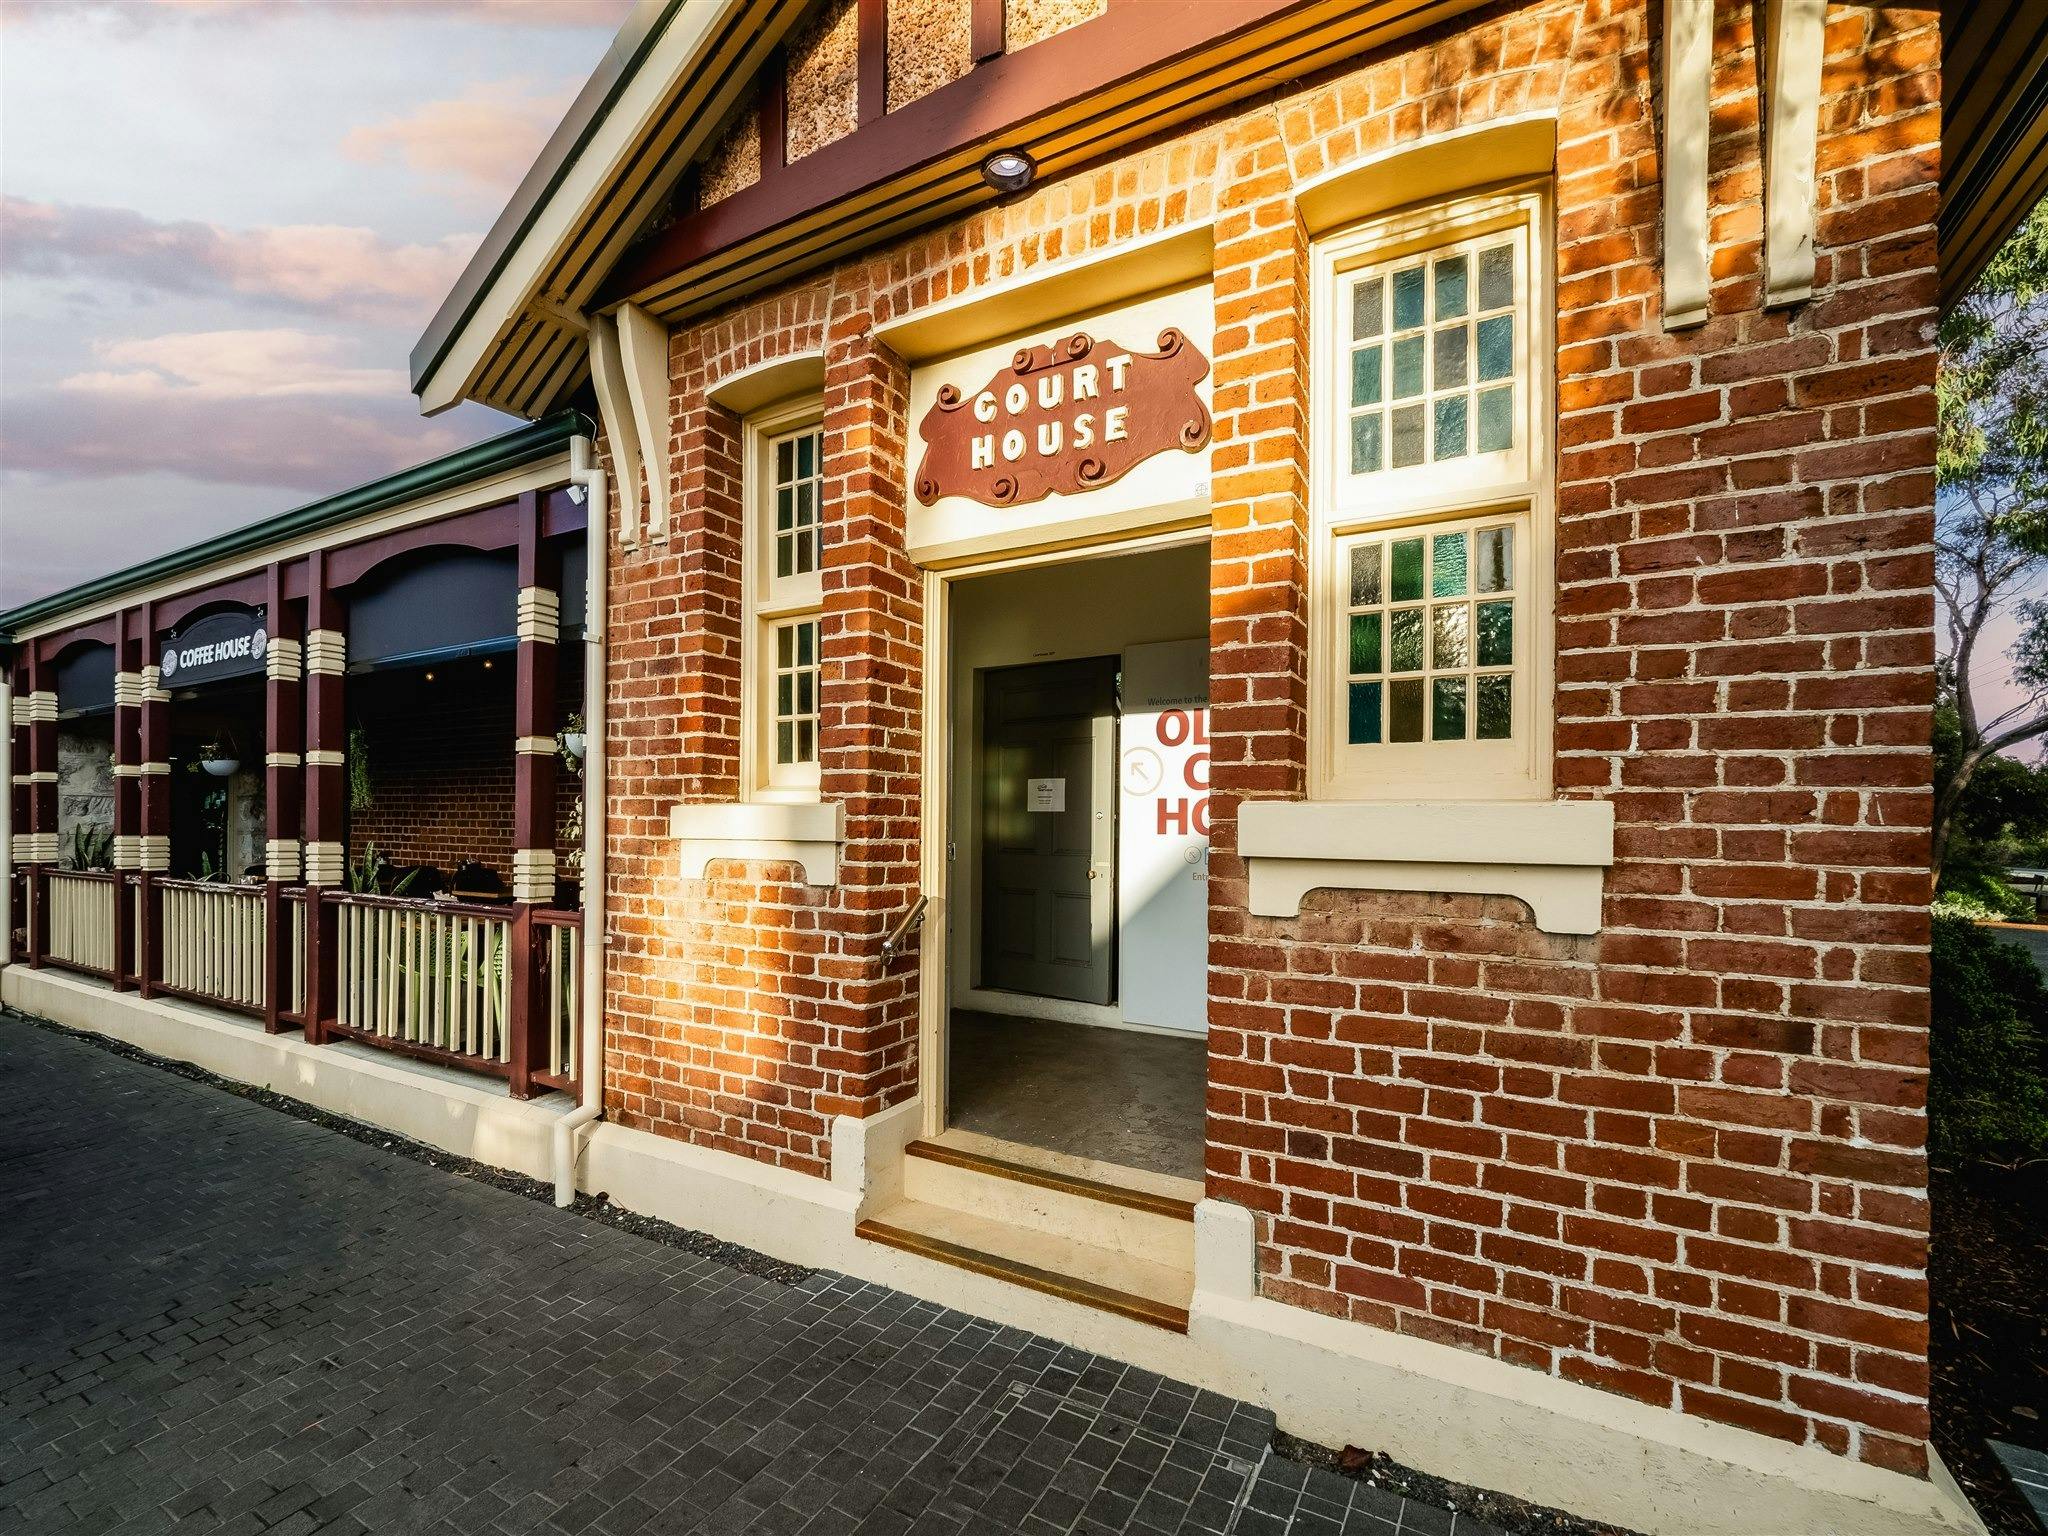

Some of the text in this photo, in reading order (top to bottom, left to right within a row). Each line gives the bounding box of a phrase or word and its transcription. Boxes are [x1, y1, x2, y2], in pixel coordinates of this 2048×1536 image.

[973, 354, 1132, 423] COURT
[971, 405, 1129, 470] HOUSE
[180, 635, 251, 668] COFFEE HOUSE
[1147, 696, 1182, 706] Welcome
[1194, 695, 1208, 703] the
[1156, 707, 1210, 747] OL
[1183, 752, 1210, 790] C
[1156, 798, 1210, 836] HO
[1192, 872, 1209, 881] Entr
